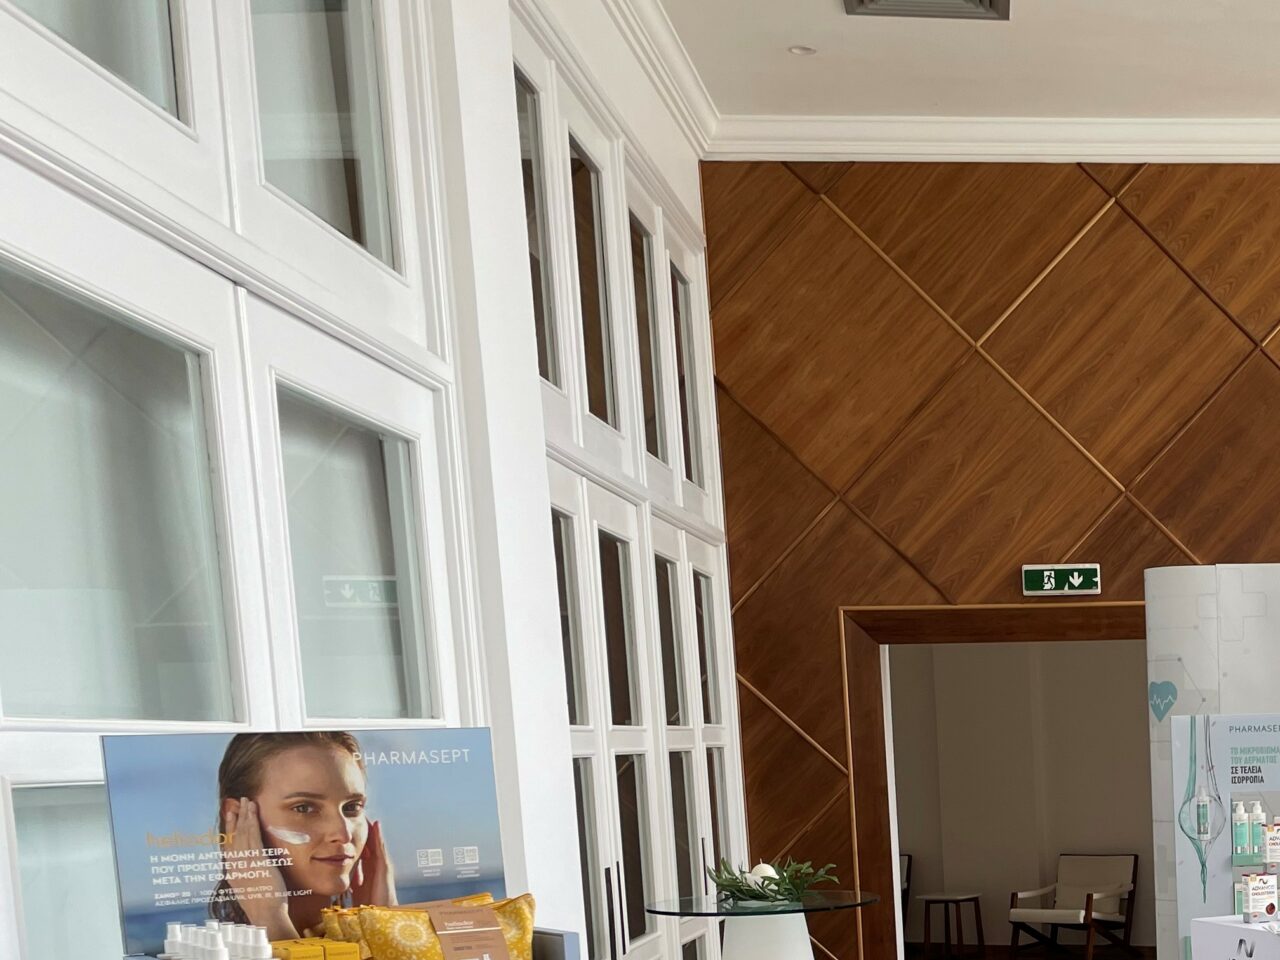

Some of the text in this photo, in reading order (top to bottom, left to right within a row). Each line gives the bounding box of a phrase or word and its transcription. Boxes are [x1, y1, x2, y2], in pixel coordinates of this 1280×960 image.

[352, 749, 470, 766] PHARMASEPT
[1231, 765, 1262, 774] ΣΕ ΤΕΛΕΙΑ
[1231, 775, 1264, 784] ΙΣΟΡΡΟΠΙΑ
[262, 847, 290, 857] ΣΕΙΡΑ
[177, 861, 248, 873] ΠΡΟΣΤΑΤΕΥΕΙ
[250, 857, 293, 868] ΑΜΕΣΩΣ
[153, 876, 181, 885] ΜΕΤΑ
[184, 874, 206, 883] ΤΗΝ
